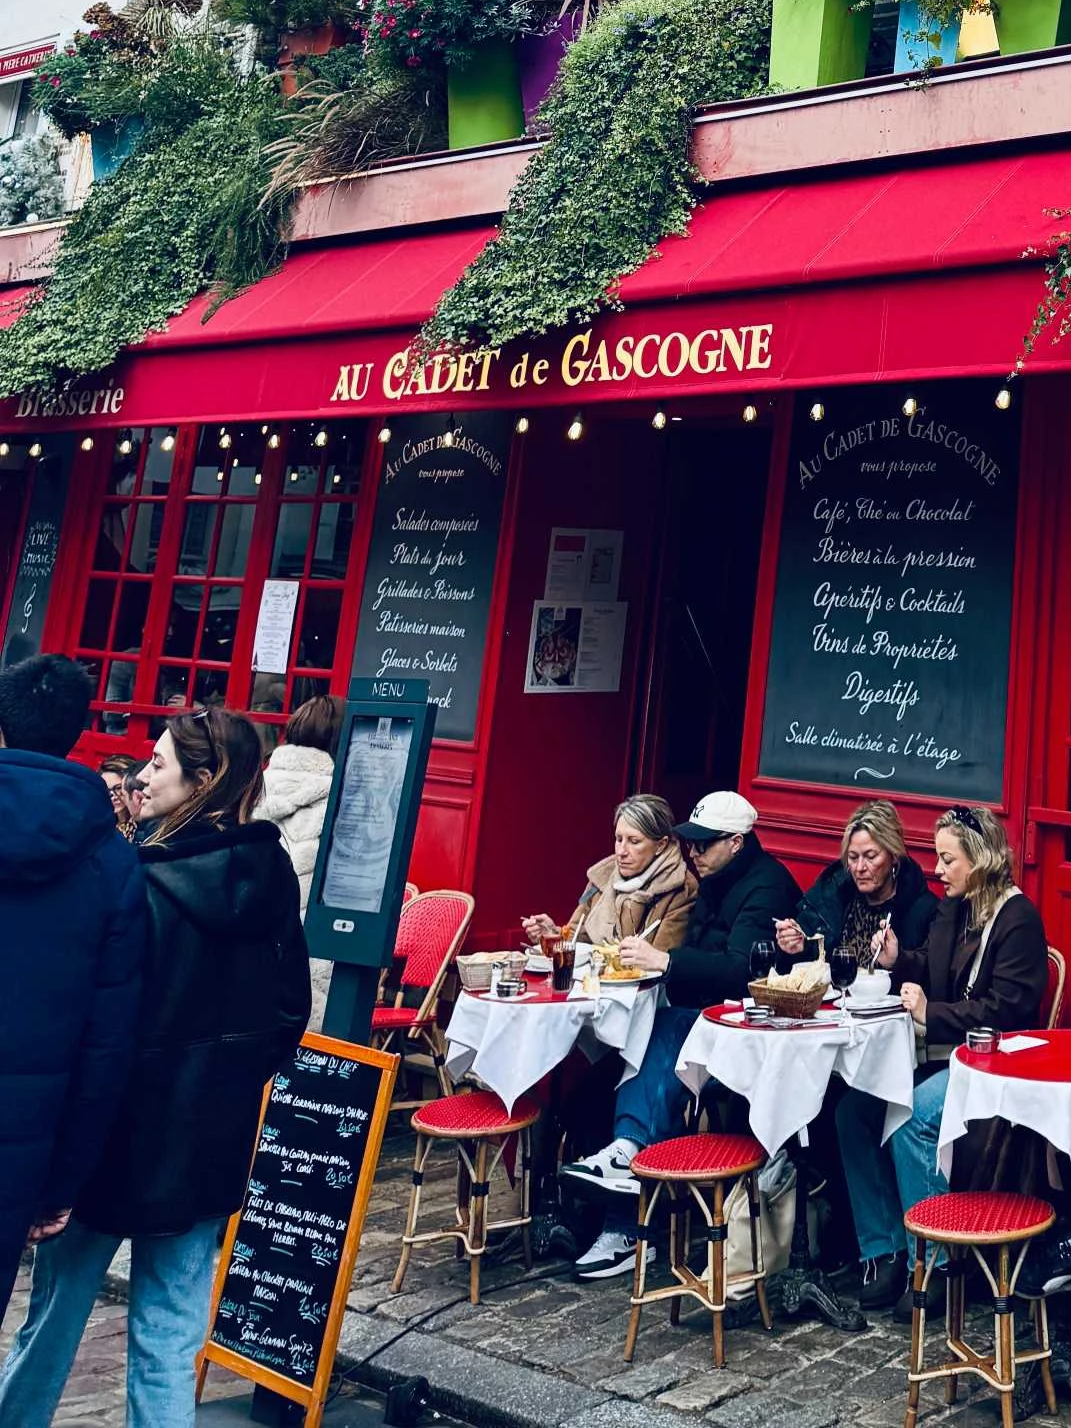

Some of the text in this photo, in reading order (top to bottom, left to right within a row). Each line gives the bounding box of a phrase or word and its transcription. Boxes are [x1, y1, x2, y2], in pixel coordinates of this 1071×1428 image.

[329, 324, 774, 402] AU CADET de GASCOGNE
[402, 439, 436, 465] CADET
[823, 419, 877, 462] CADET
[880, 417, 901, 439] DE
[906, 406, 1002, 487] GASCOGNE
[860, 459, 937, 480] vous propose
[391, 507, 480, 541] Salades composées
[812, 497, 976, 534] Café, Thé ou Chocolat
[389, 541, 467, 576] Plats du jour
[812, 535, 977, 578] Bières à la pression
[371, 577, 423, 611] Grillades
[431, 578, 476, 601] Poissons
[812, 581, 883, 624] Apéritifs
[899, 587, 966, 615] Cocktails
[429, 620, 467, 639] maison
[812, 623, 959, 670] Vins de Propriétés
[375, 647, 411, 678] Glaces
[420, 649, 459, 673] Sorbets
[372, 682, 406, 697] MENU
[841, 670, 921, 722] Digestifs
[785, 721, 818, 746] Salle
[820, 727, 884, 753] climatisée
[887, 738, 901, 754] à
